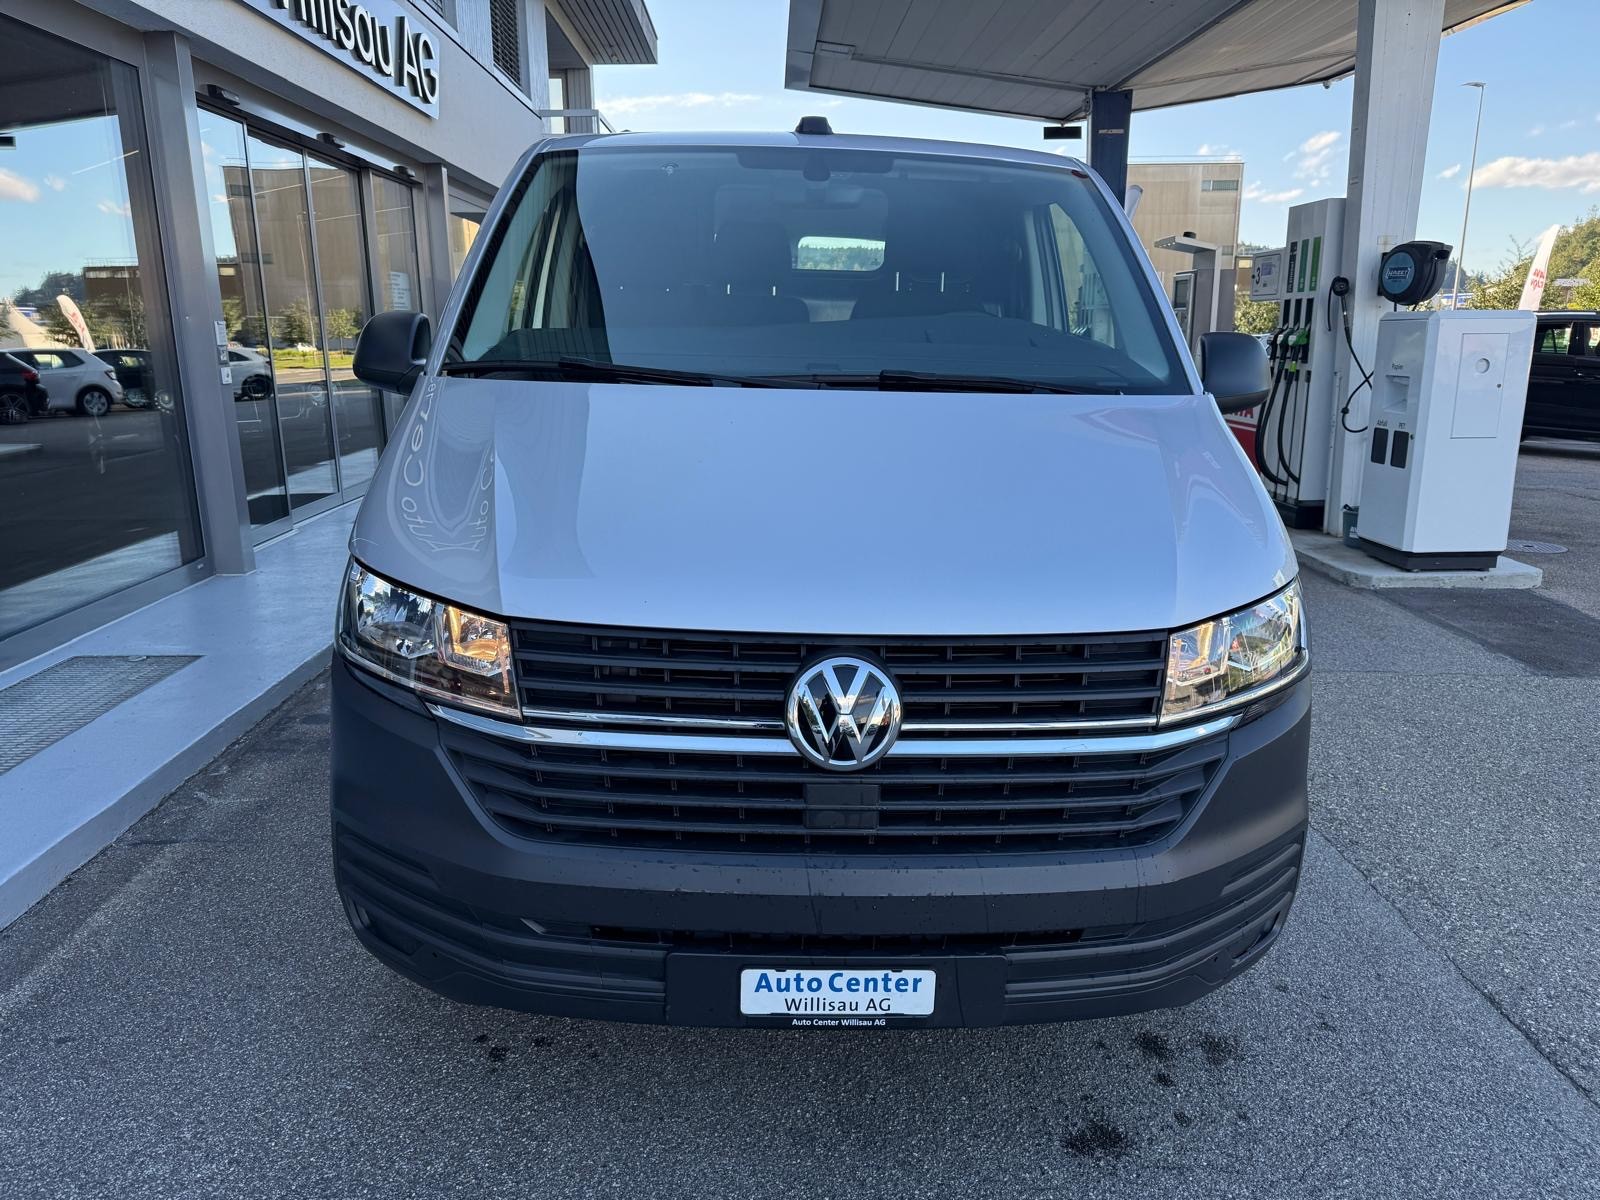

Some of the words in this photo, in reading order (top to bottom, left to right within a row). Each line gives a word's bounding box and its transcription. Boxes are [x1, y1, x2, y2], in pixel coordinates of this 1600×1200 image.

[399, 16, 439, 104] AG
[1255, 267, 1261, 285] 3
[787, 656, 901, 771] VW
[754, 972, 822, 993] Auto
[828, 972, 923, 993] Center
[784, 997, 859, 1012] Willisau
[866, 998, 891, 1012] AG
[792, 1018, 812, 1026] Auto
[813, 1018, 840, 1026] Center
[841, 1018, 872, 1026] Willisau
[873, 1018, 886, 1026] AG
